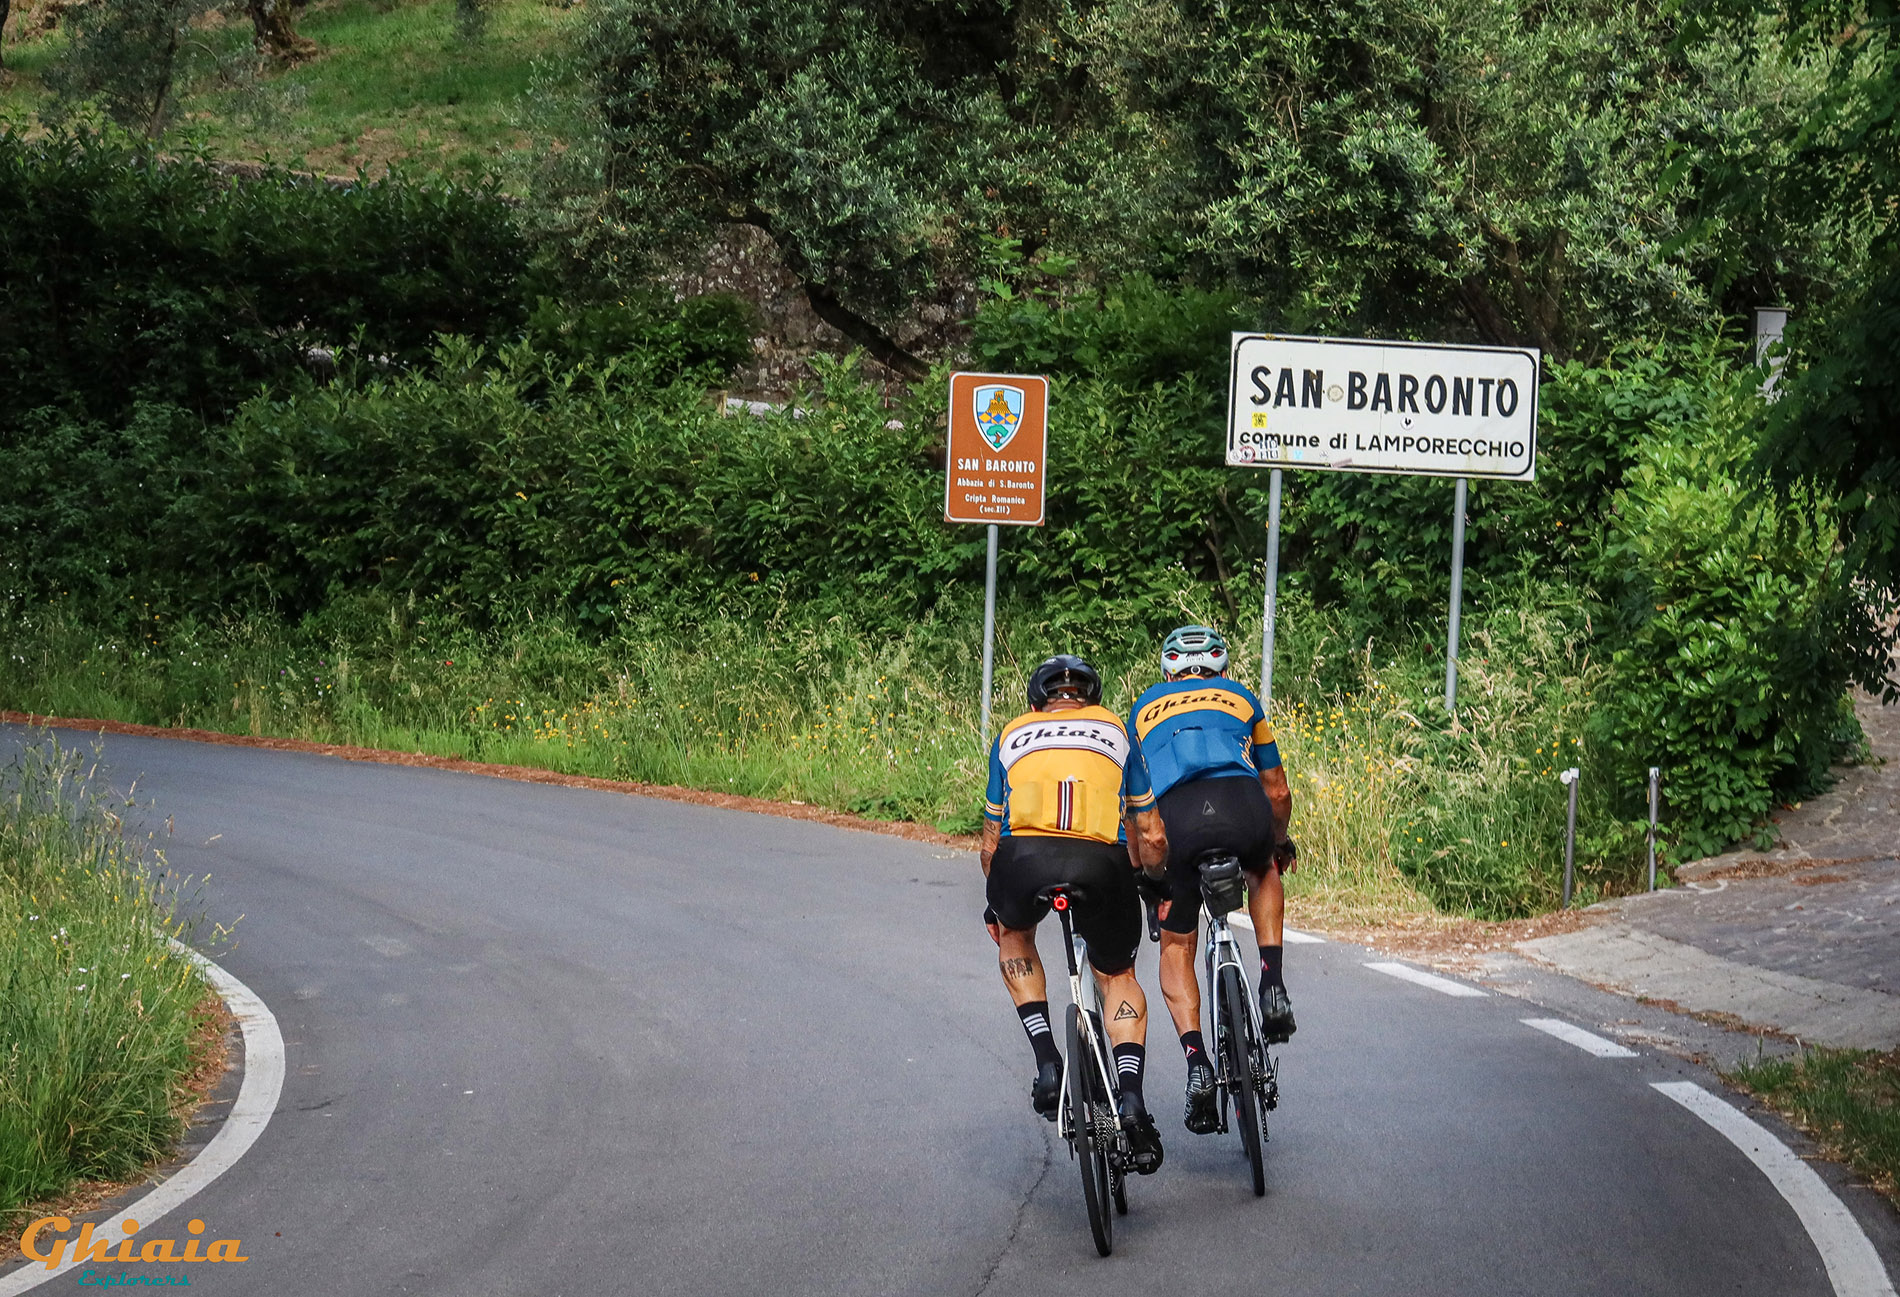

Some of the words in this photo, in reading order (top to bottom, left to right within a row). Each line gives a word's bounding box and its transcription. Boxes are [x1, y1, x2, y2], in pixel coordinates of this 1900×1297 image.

[1250, 366, 1324, 409] SAN
[1347, 371, 1519, 418] BARONTO
[1239, 431, 1320, 449] comune
[1329, 433, 1347, 450] di
[1355, 434, 1525, 458] LAMPORECCHIO
[957, 458, 979, 471] SAN
[985, 459, 1036, 473] BARONTO
[957, 477, 984, 488] Abbazia
[988, 478, 995, 488] di
[964, 493, 987, 504] Cripta
[991, 494, 1026, 505] Romanica
[1143, 694, 1238, 723] Ghiaia
[1010, 726, 1118, 751] Ghiaia
